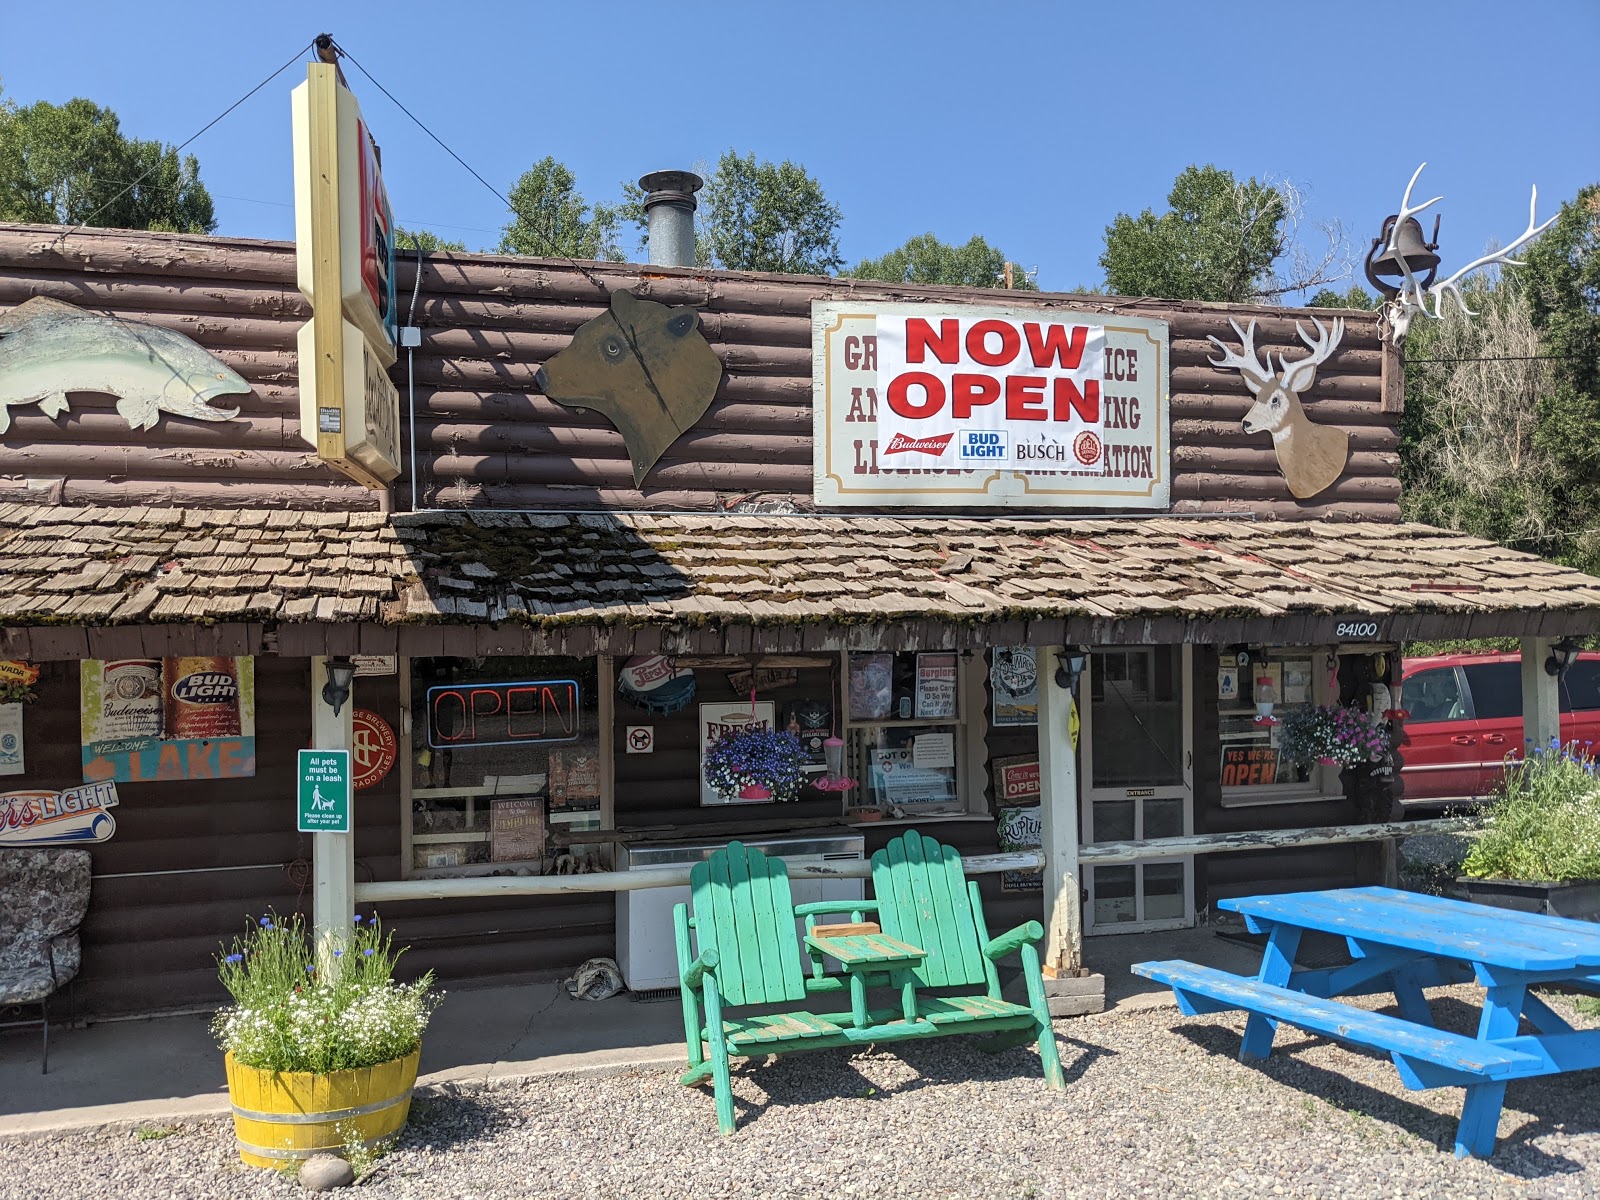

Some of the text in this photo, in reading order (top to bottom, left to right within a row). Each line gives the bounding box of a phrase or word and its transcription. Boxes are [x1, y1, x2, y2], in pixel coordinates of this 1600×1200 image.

[906, 318, 1088, 369] NOW
[887, 371, 1100, 423] OPEN
[1104, 396, 1141, 429] ING
[889, 437, 949, 450] Budweiser
[968, 433, 999, 444] BUD
[962, 445, 1006, 457] LIGHT
[1016, 444, 1065, 461] BUSCH
[1336, 622, 1377, 637] 84100
[920, 668, 956, 678] Burglars
[187, 675, 233, 687] BUD
[940, 684, 955, 692] Carry
[179, 685, 237, 698] LIGHT
[103, 701, 163, 718] Budweise
[434, 685, 573, 740] OPEN
[365, 713, 393, 746] BREWERY
[707, 719, 768, 740] FRESH
[93, 740, 150, 755] WELCOME
[129, 742, 243, 781] LAKE
[321, 758, 337, 766] pets
[1227, 750, 1244, 761] YES
[378, 754, 392, 775] ALES
[323, 774, 342, 782] leash
[1007, 769, 1023, 780] Come
[1223, 763, 1277, 786] OPEN
[37, 781, 113, 820] LIGHT
[497, 800, 537, 808] WELCOME
[1004, 815, 1041, 843] RUPTU
